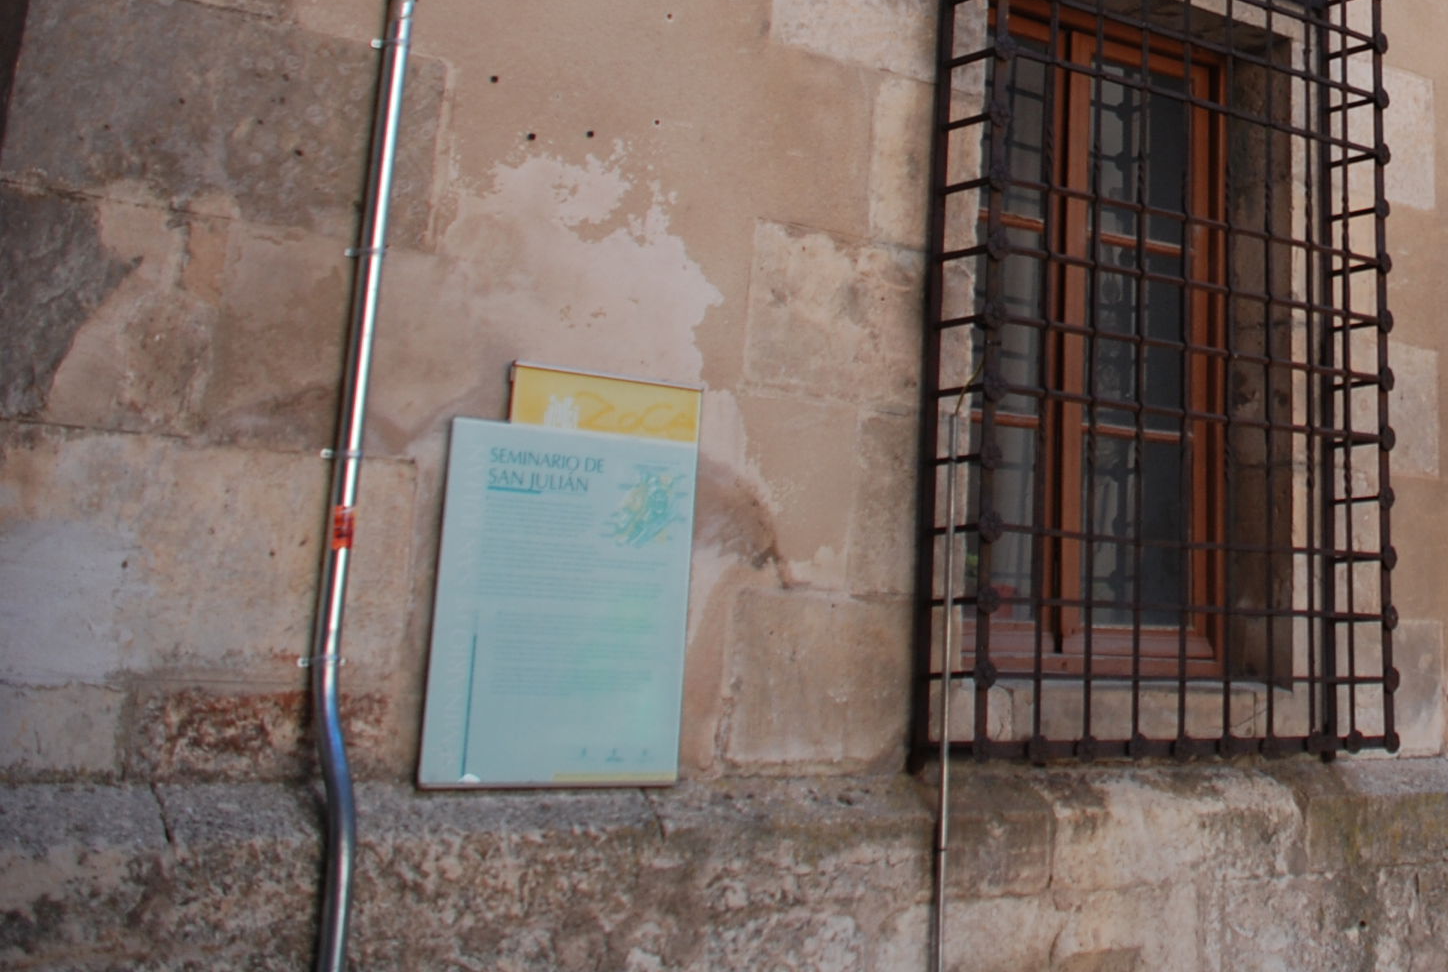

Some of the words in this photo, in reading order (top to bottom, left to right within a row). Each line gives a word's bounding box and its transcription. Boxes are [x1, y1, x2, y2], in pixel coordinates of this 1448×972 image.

[489, 447, 580, 471] SEMINARIO
[584, 457, 605, 474] DE
[488, 468, 523, 486] SAN
[528, 469, 588, 493] JULIÁN
